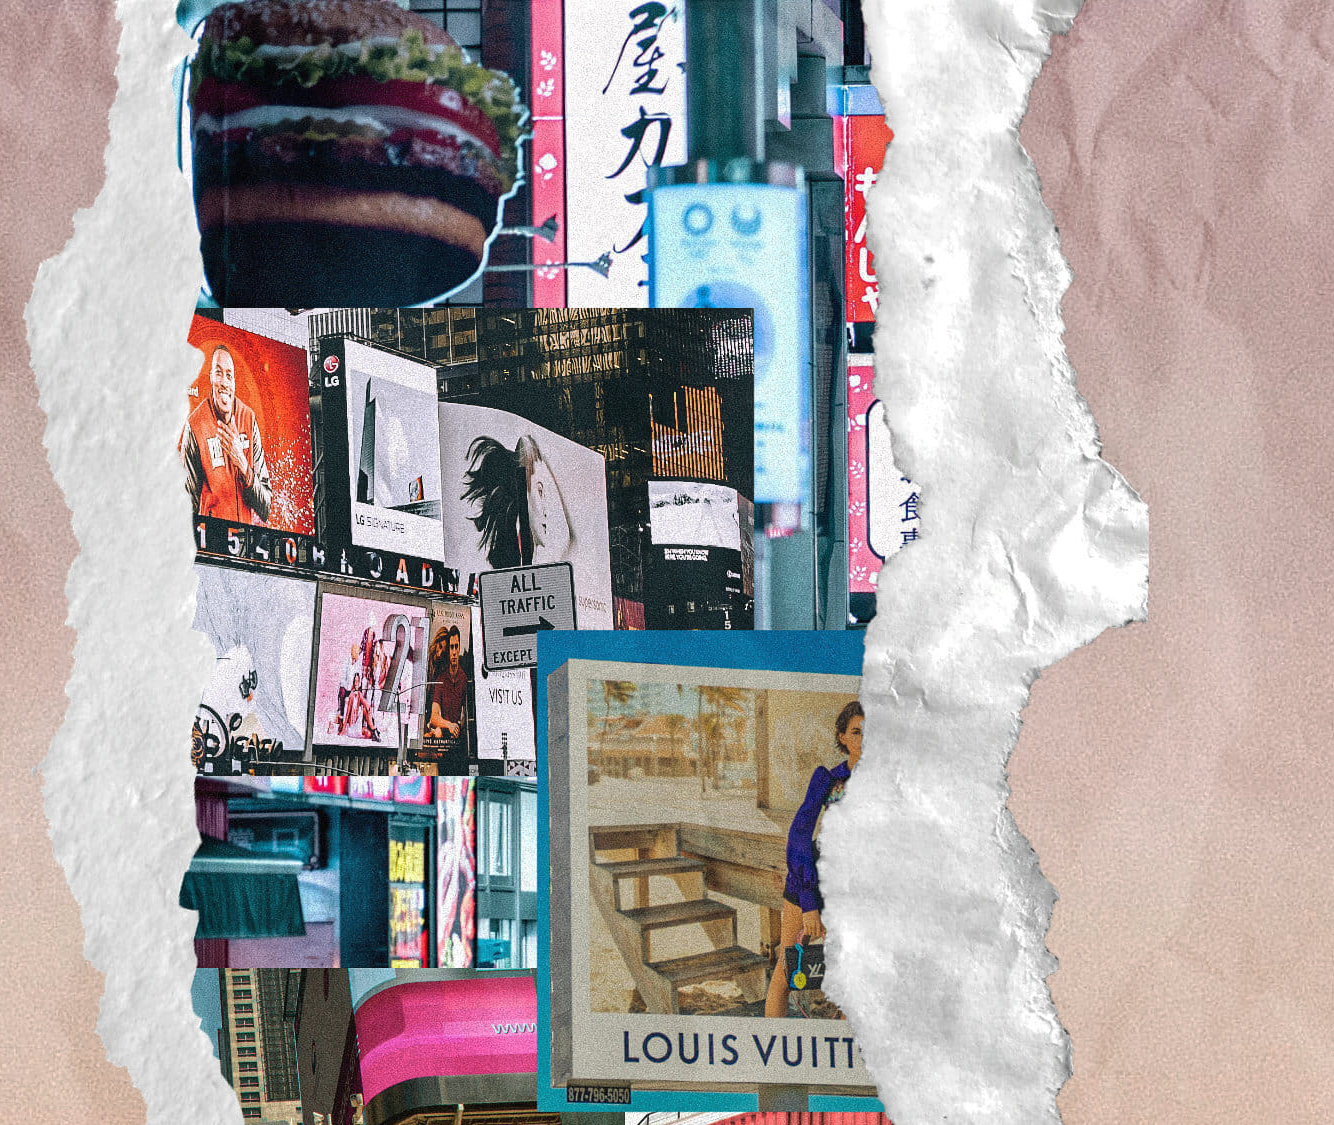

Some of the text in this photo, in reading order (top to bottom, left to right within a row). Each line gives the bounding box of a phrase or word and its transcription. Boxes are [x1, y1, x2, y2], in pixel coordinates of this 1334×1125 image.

[324, 376, 339, 387] LG
[510, 572, 542, 594] ALL
[499, 595, 556, 615] TRAFFIC
[493, 649, 533, 664] EXCEPT
[488, 688, 523, 706] VISIT US
[623, 1030, 740, 1066] LOUIS
[568, 1086, 631, 1104] 877-796-5050
